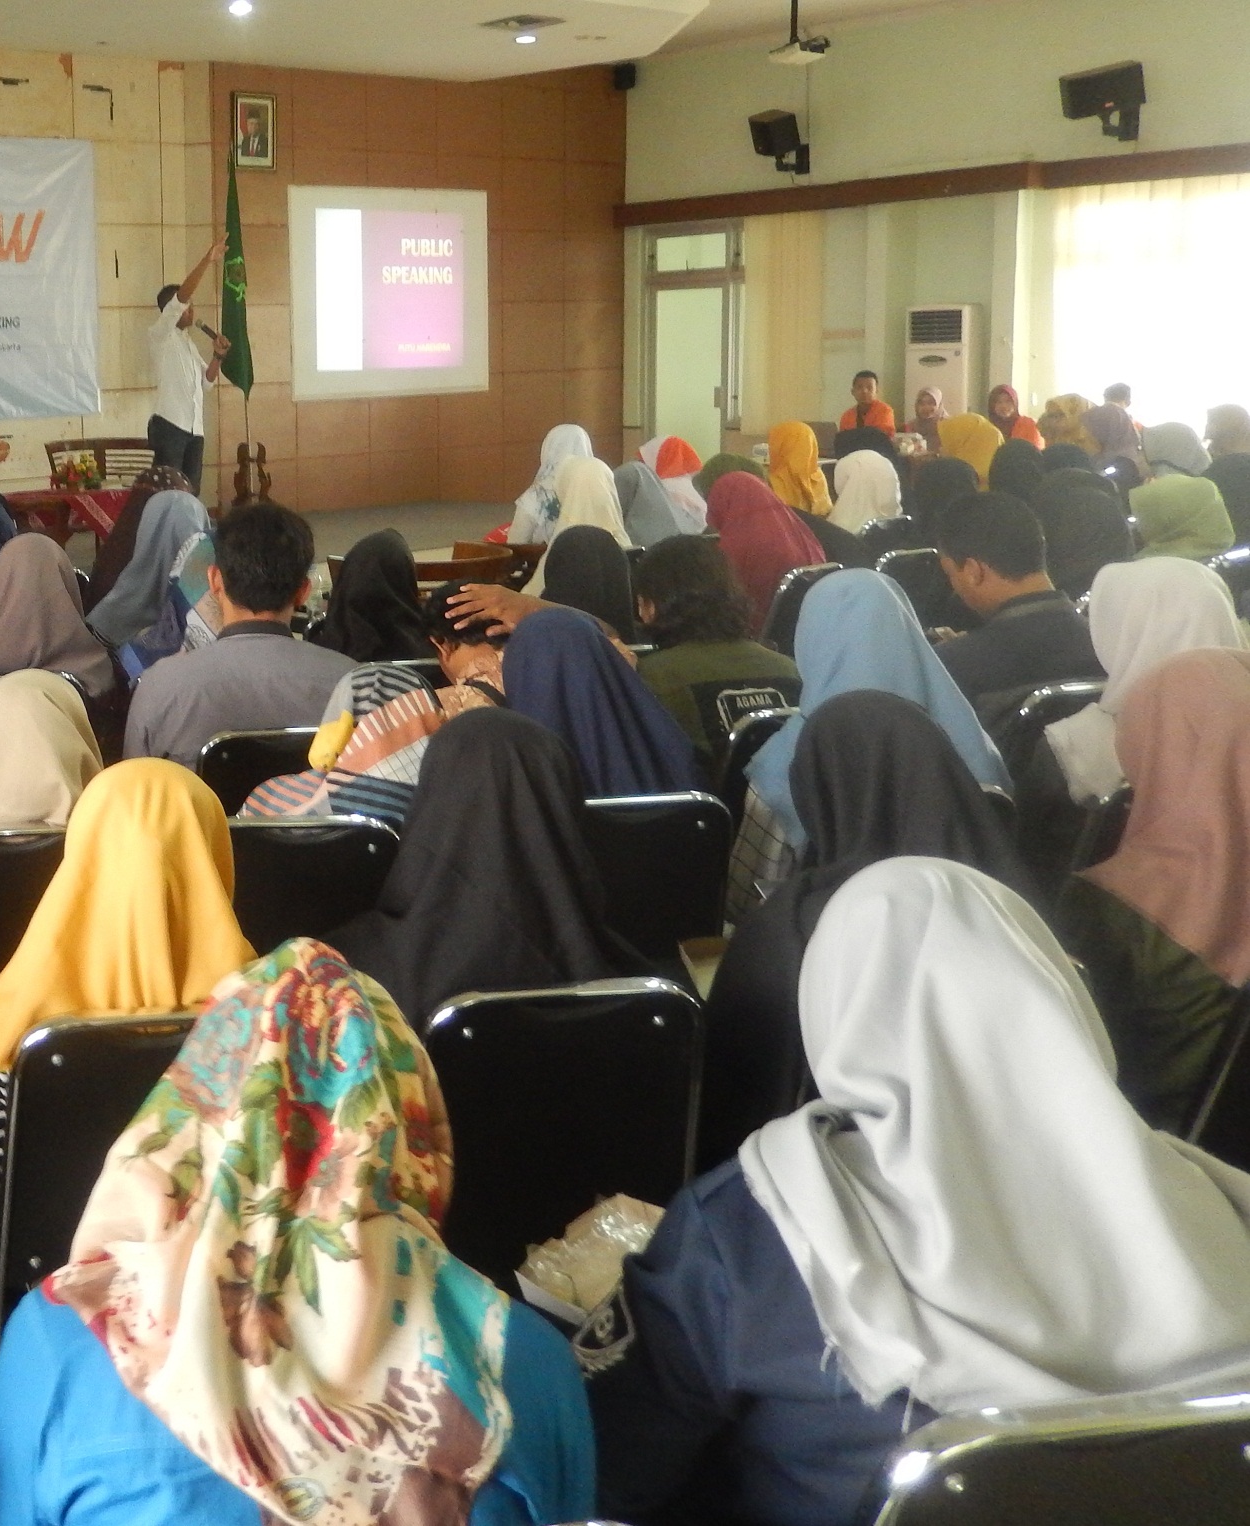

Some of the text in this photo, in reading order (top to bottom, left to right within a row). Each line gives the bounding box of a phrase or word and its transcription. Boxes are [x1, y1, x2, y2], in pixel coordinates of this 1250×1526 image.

[401, 238, 453, 257] PUBLIC
[382, 266, 453, 285] SPEAKING
[735, 693, 774, 709] AGAMA
